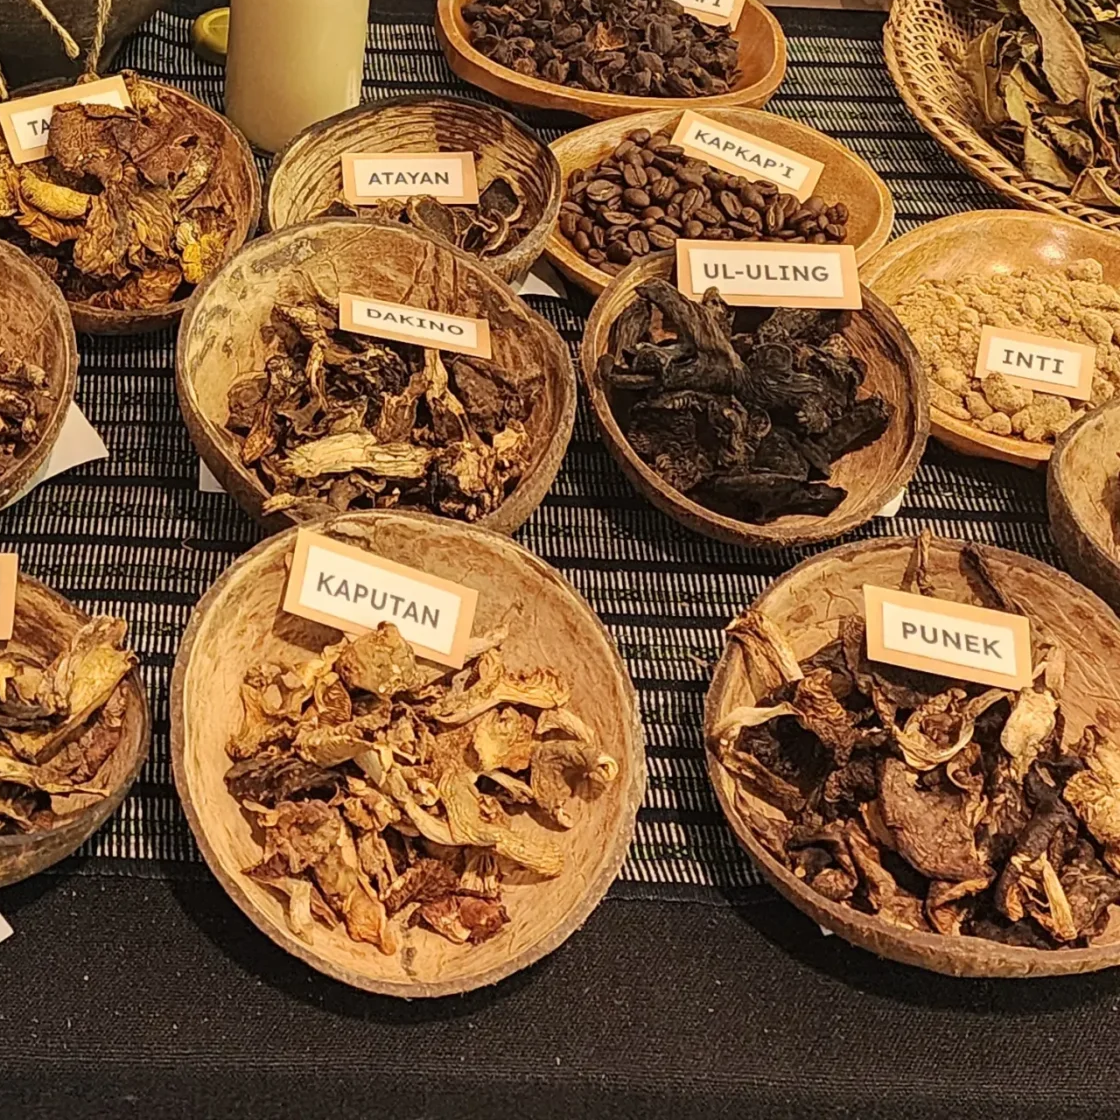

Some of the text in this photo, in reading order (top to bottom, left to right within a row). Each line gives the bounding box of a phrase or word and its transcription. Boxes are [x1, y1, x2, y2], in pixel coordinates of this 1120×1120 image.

[694, 129, 795, 179] KAPKAP'I
[368, 171, 449, 185] ATAYAN
[703, 263, 829, 282] UL-ULING
[367, 308, 465, 336] DAKINO
[1002, 349, 1065, 375] INTI
[316, 572, 440, 629] KAPUTAN
[901, 621, 1003, 660] PUNEK
